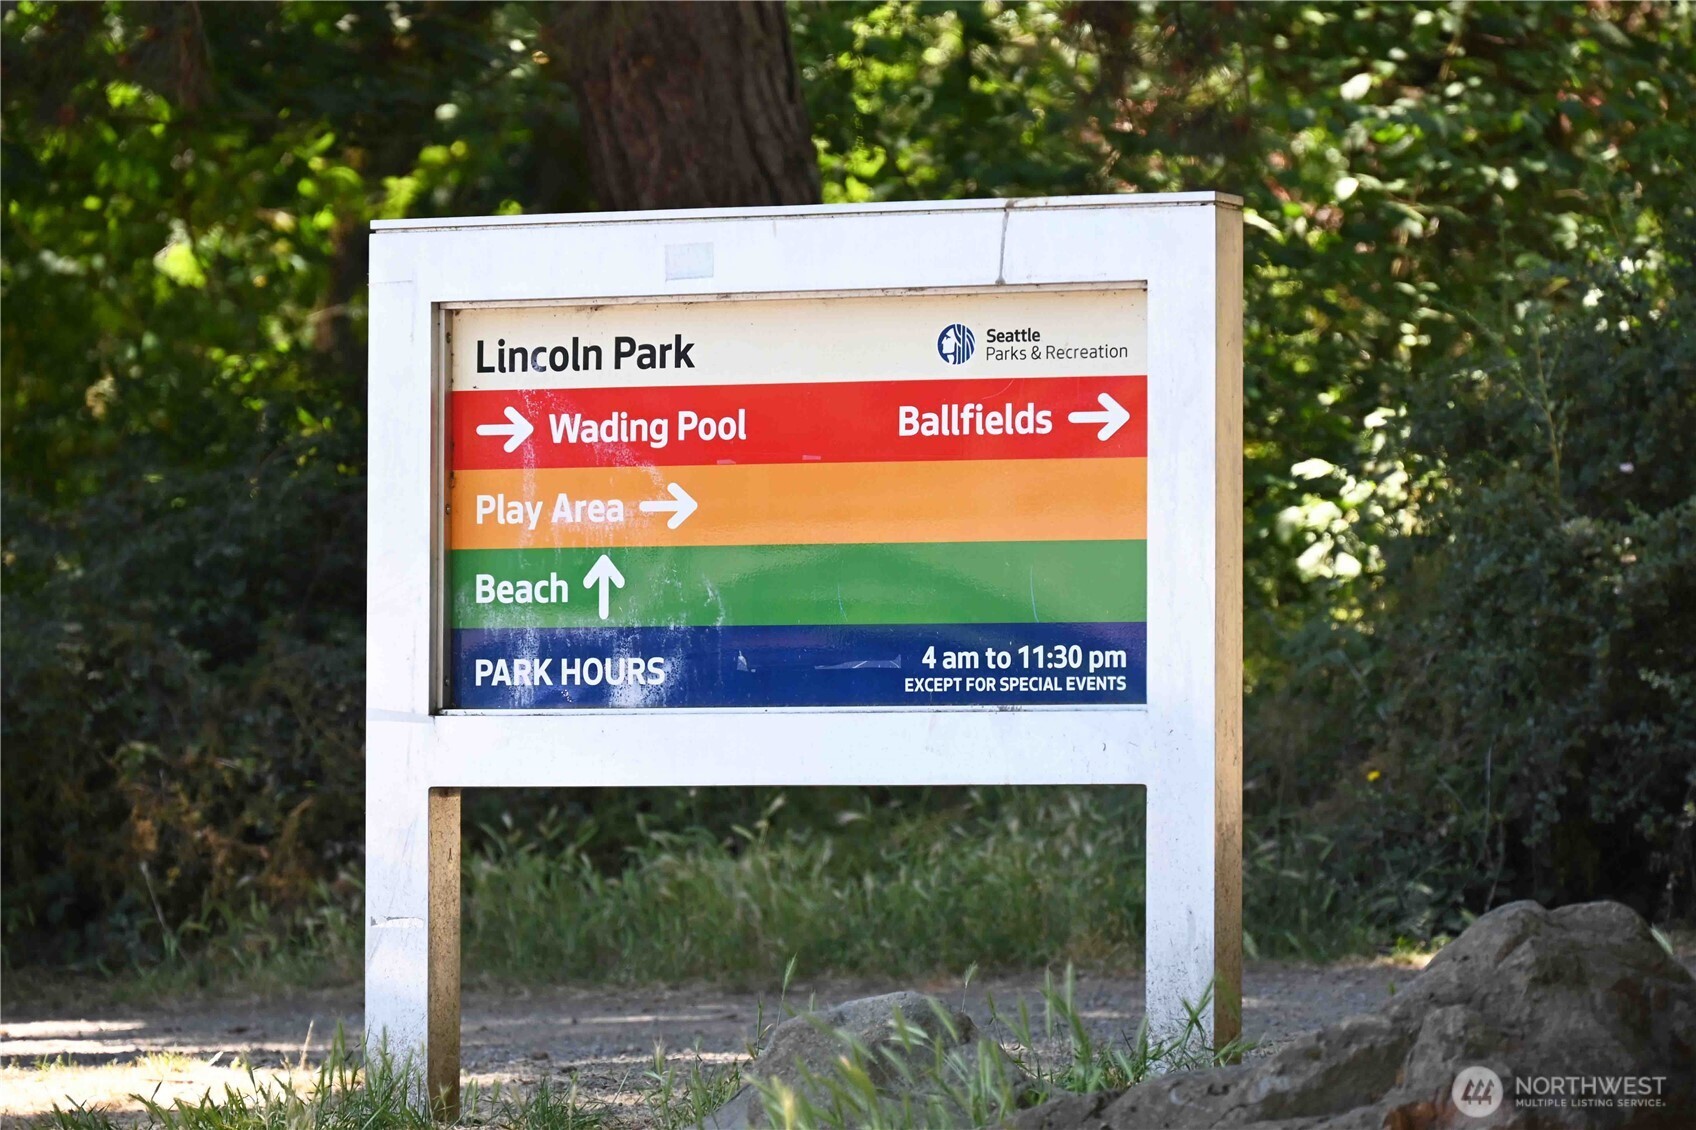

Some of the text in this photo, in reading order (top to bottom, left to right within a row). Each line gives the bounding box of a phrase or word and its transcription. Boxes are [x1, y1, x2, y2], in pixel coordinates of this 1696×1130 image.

[986, 327, 1041, 343] Seattle
[476, 333, 696, 374] Lincoln Park
[986, 344, 1128, 361] Parks & Recreation
[548, 408, 747, 449] Wading Pool
[898, 402, 1053, 437] Ballfields
[476, 492, 625, 531] Play Area
[475, 572, 569, 604] Beach
[475, 656, 665, 686] PARK HOURS
[921, 644, 1127, 673] 4 am to 11:30 pm
[904, 675, 1127, 693] EXCEPT FOR SPECIAL EVENTS
